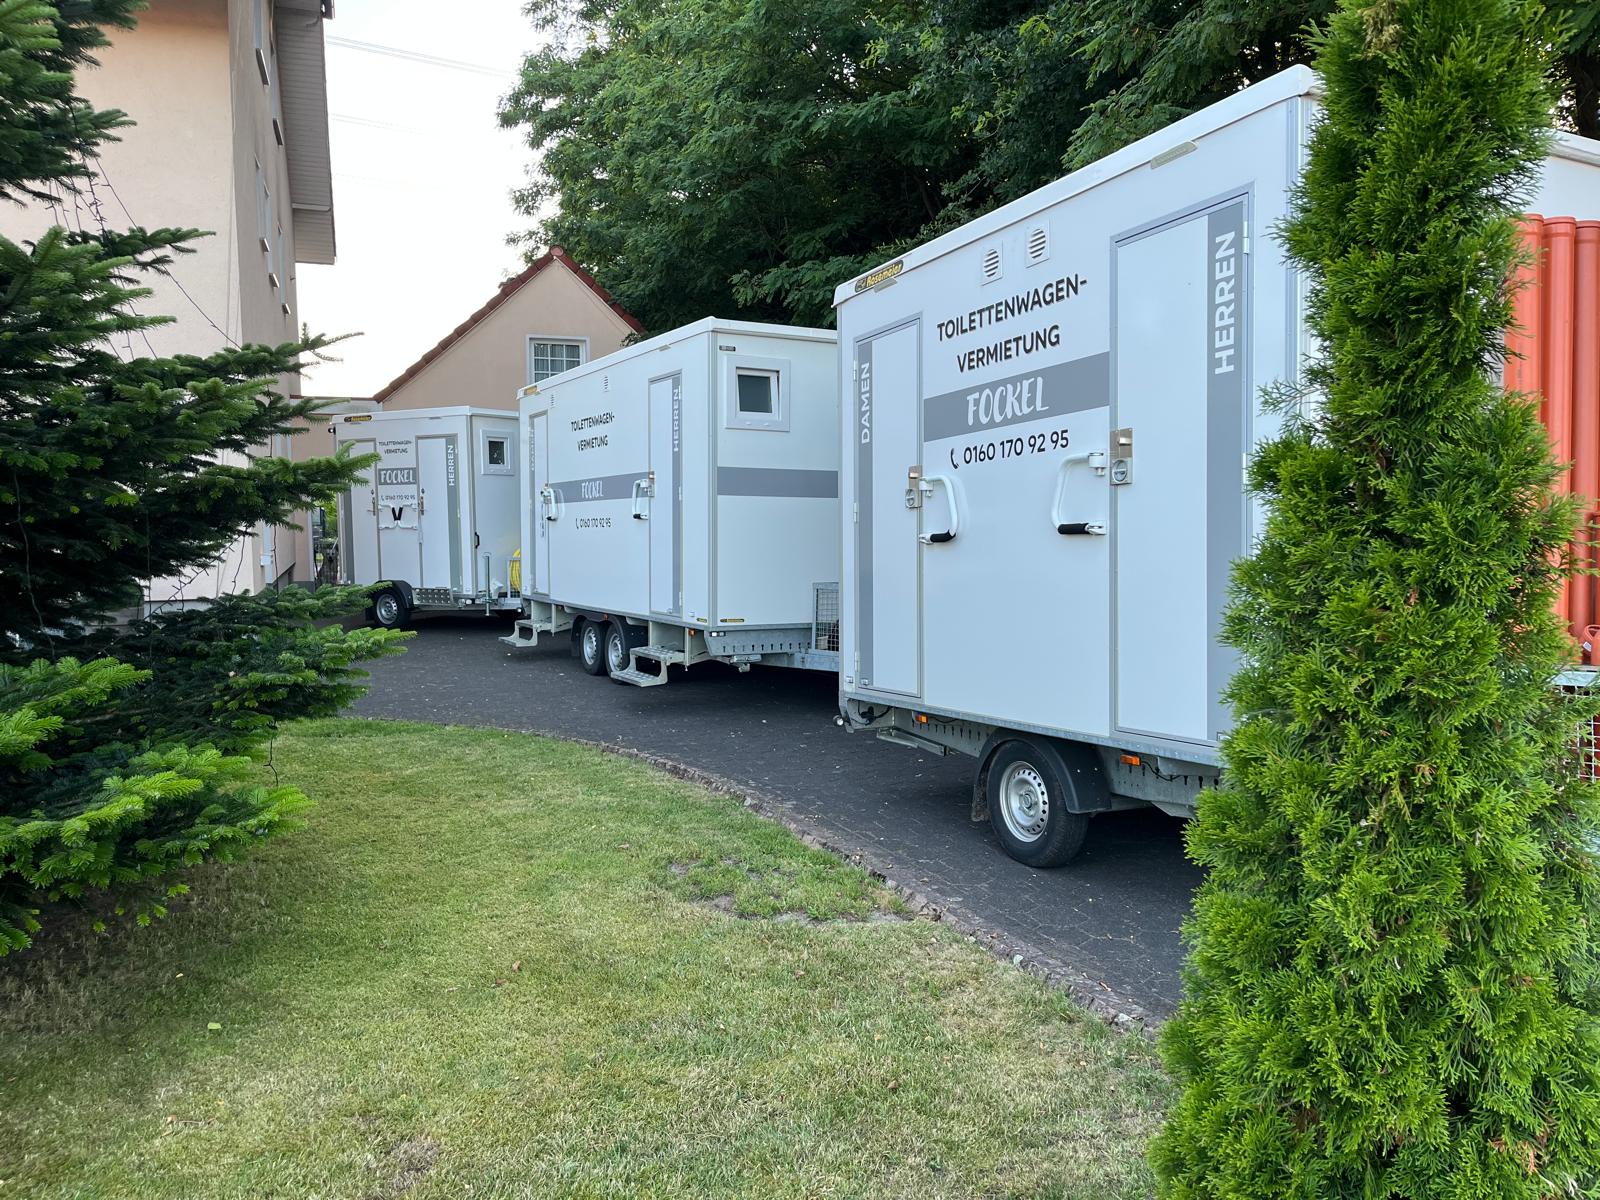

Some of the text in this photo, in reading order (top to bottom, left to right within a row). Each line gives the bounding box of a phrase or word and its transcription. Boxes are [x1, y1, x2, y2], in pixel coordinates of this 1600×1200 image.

[937, 273, 1087, 341] TOILETTENWAGEN-
[1214, 231, 1235, 375] HERREN
[957, 324, 1060, 373] VERMIETUNG
[571, 411, 615, 432] TOILETTENWAGEN-
[672, 388, 680, 452] HERREN
[861, 362, 870, 443] DAMEN
[966, 376, 1049, 426] FOCKEL
[577, 435, 608, 451] VERMIETUNG
[964, 429, 1069, 465] 0160 170 92 95
[381, 469, 416, 484] FOCKEL
[581, 480, 604, 499] FOCKEL
[599, 517, 605, 528] 92
[605, 517, 611, 528] 95
